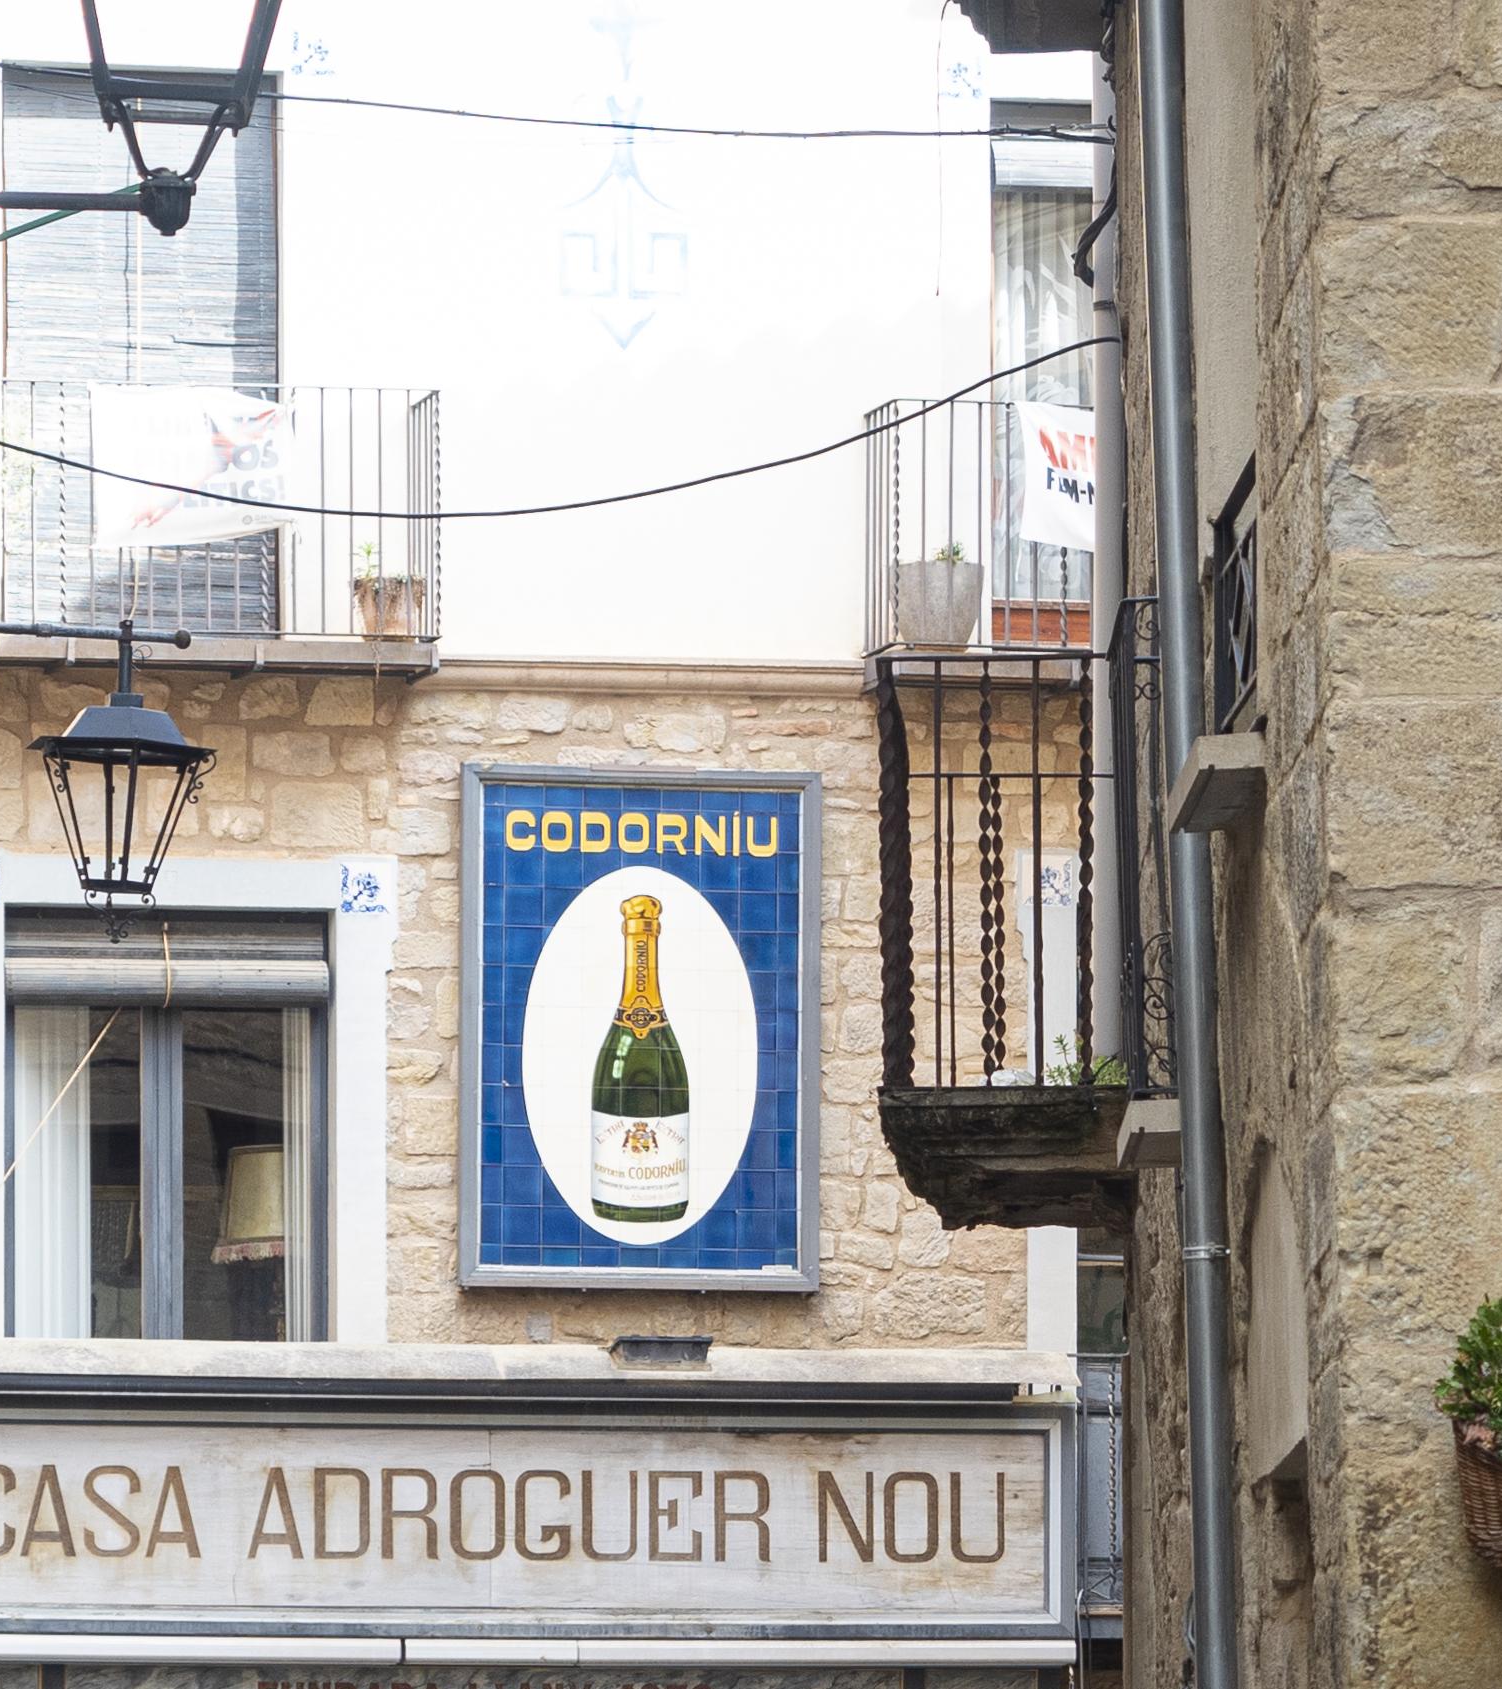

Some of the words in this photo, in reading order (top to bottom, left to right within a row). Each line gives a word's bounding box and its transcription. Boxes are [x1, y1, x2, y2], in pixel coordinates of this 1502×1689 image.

[505, 810, 778, 858] CODORNÍU
[630, 1014, 651, 1022] DRY
[247, 1467, 771, 1563] ADROGUER
[817, 1470, 1006, 1564] NOU
